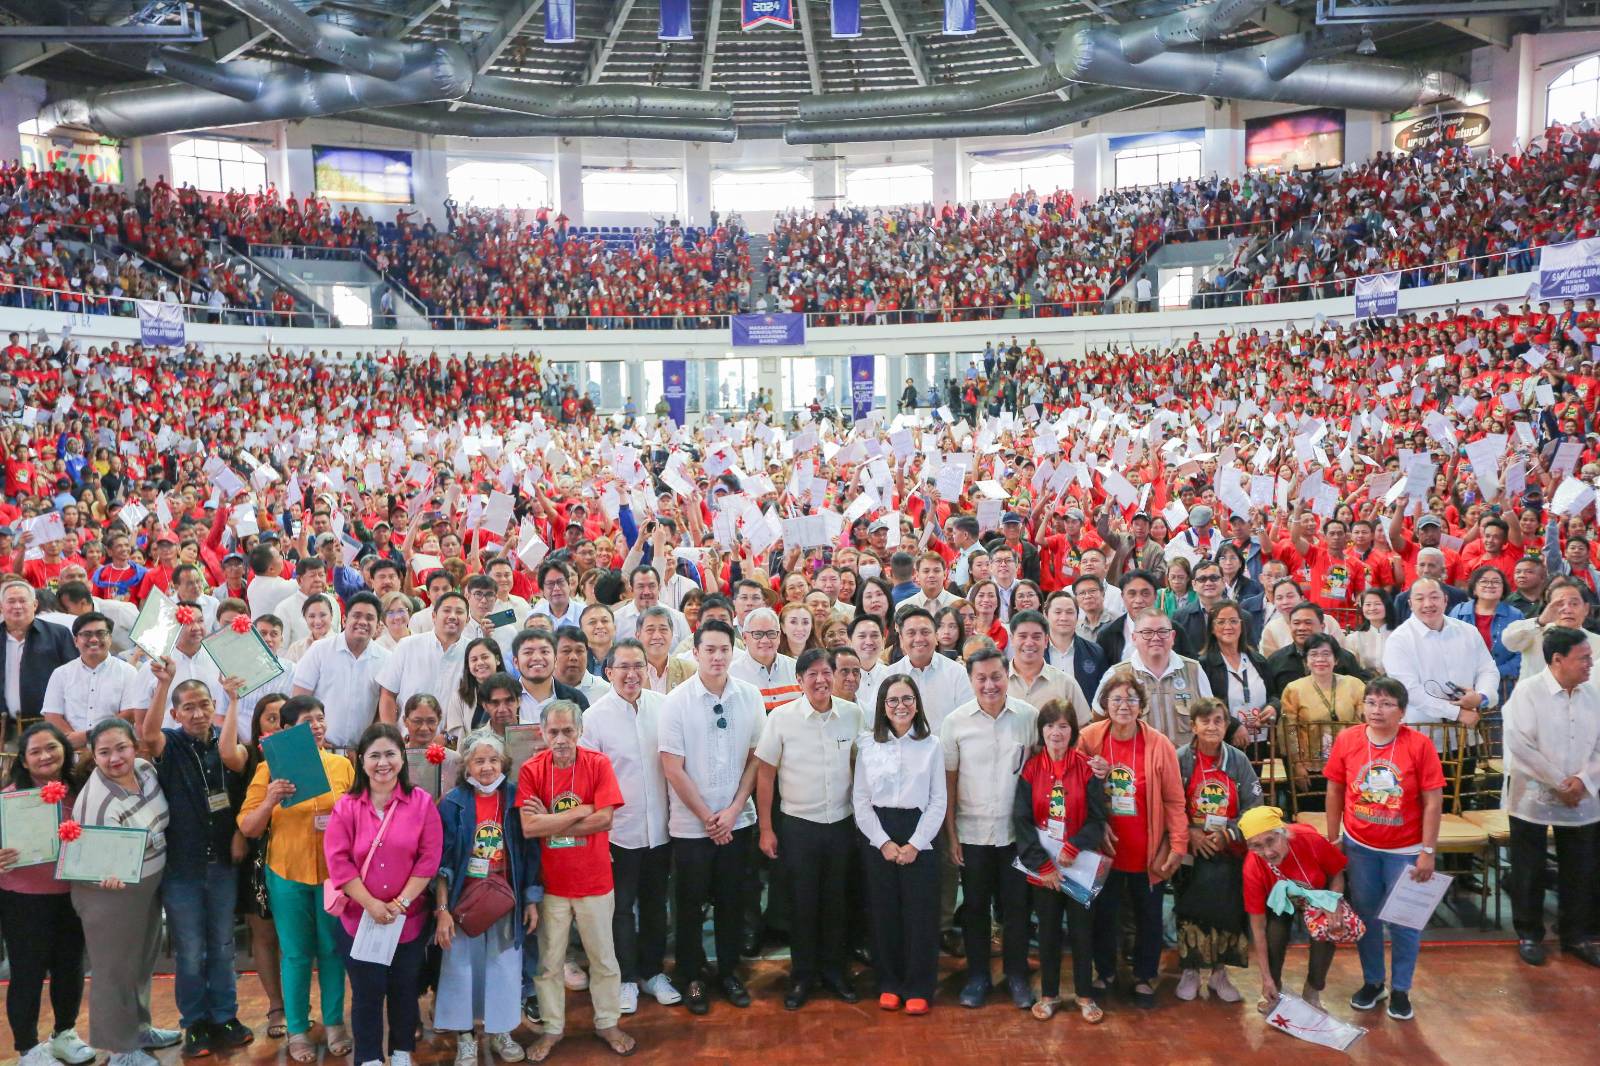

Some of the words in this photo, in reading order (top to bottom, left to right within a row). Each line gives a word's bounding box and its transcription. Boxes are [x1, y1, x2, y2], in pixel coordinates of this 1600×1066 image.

[752, 1, 780, 12] 2024
[1412, 116, 1464, 133] Serbiyong
[1445, 123, 1483, 140] Natural
[1561, 283, 1590, 294] PILIPINO
[1111, 771, 1130, 780] DAR
[1203, 786, 1222, 795] DAR
[557, 800, 579, 810] DAR
[480, 829, 499, 838] DAR
